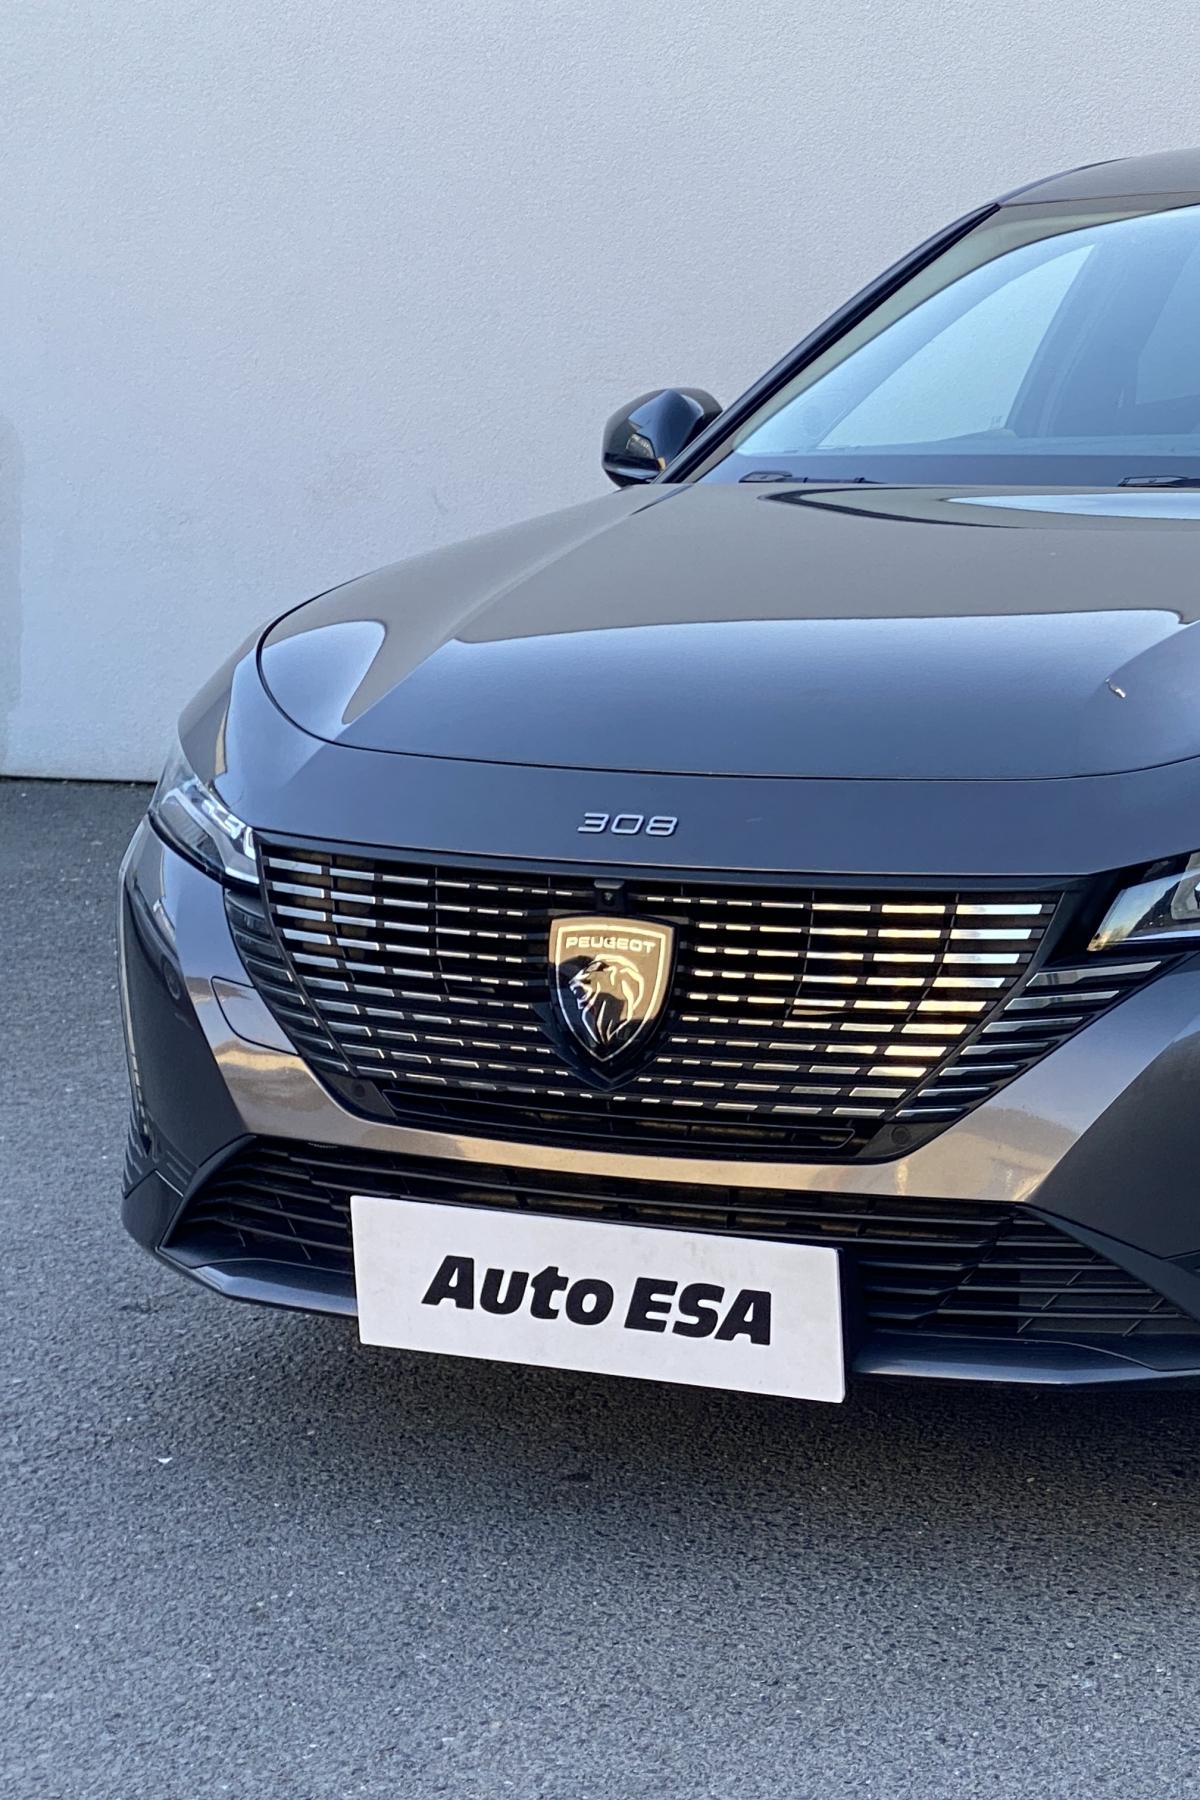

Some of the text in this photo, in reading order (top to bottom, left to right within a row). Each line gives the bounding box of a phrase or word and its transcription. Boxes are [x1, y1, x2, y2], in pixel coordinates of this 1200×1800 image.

[577, 812, 678, 836] 308
[566, 936, 655, 953] PEUGEOT
[421, 1255, 771, 1345] Auto ESA
